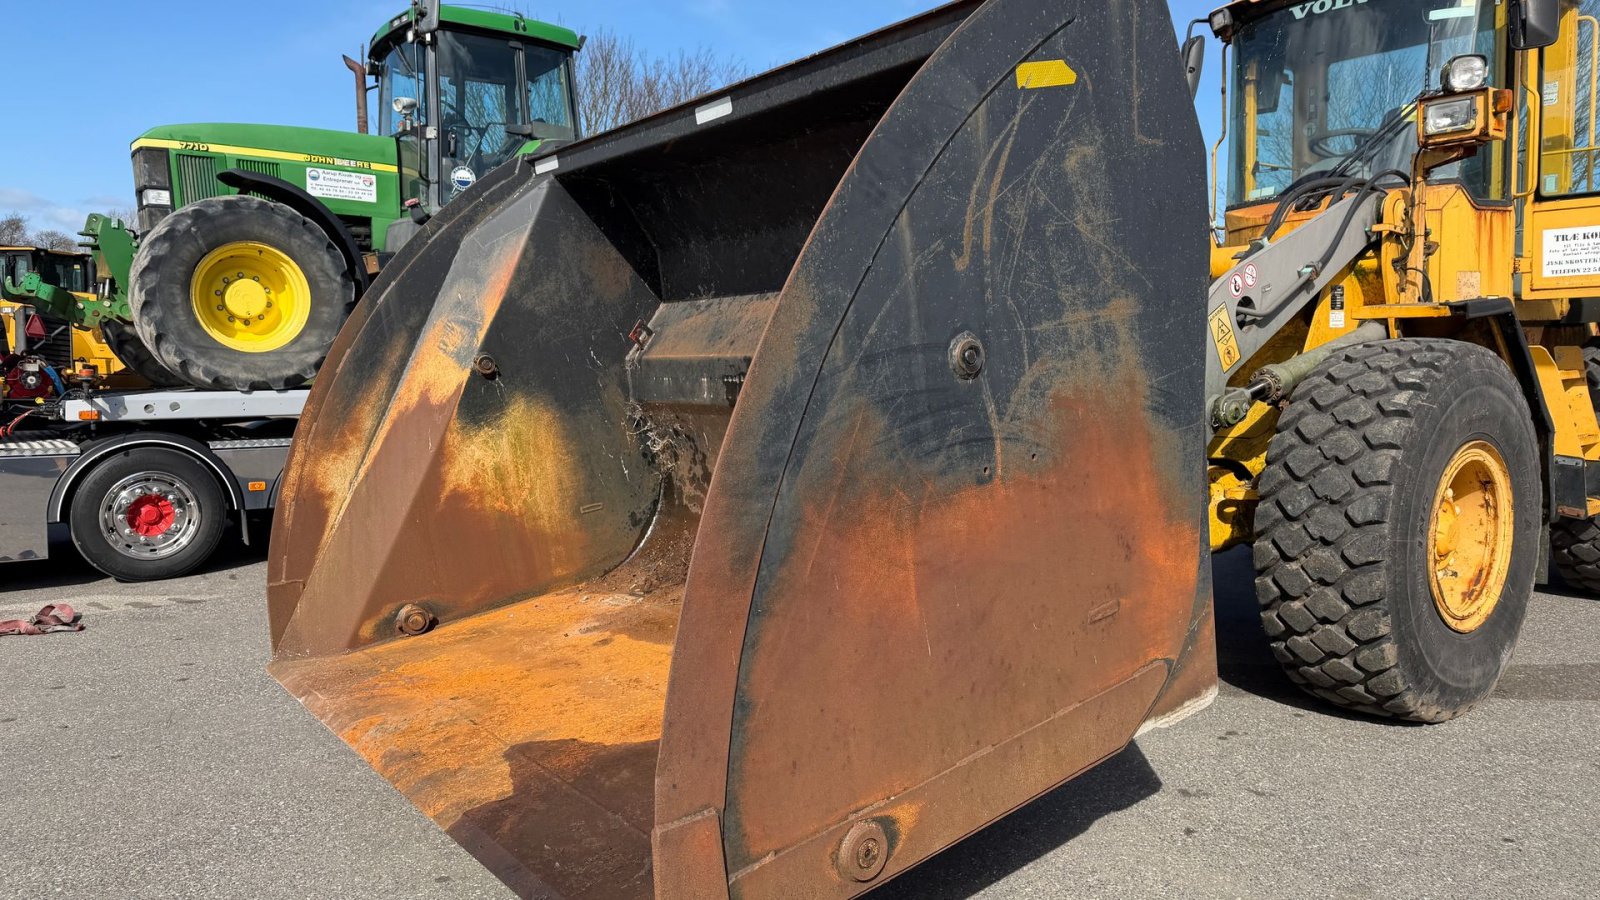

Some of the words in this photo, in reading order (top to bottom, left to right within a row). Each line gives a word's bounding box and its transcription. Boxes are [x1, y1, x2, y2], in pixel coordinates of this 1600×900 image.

[1288, 0, 1369, 20] VOL
[178, 140, 209, 151] 7710
[304, 155, 334, 164] JOHN
[334, 159, 371, 169] DEERE
[1554, 233, 1580, 242] TRÆ
[1565, 257, 1600, 265] SKOVTEK
